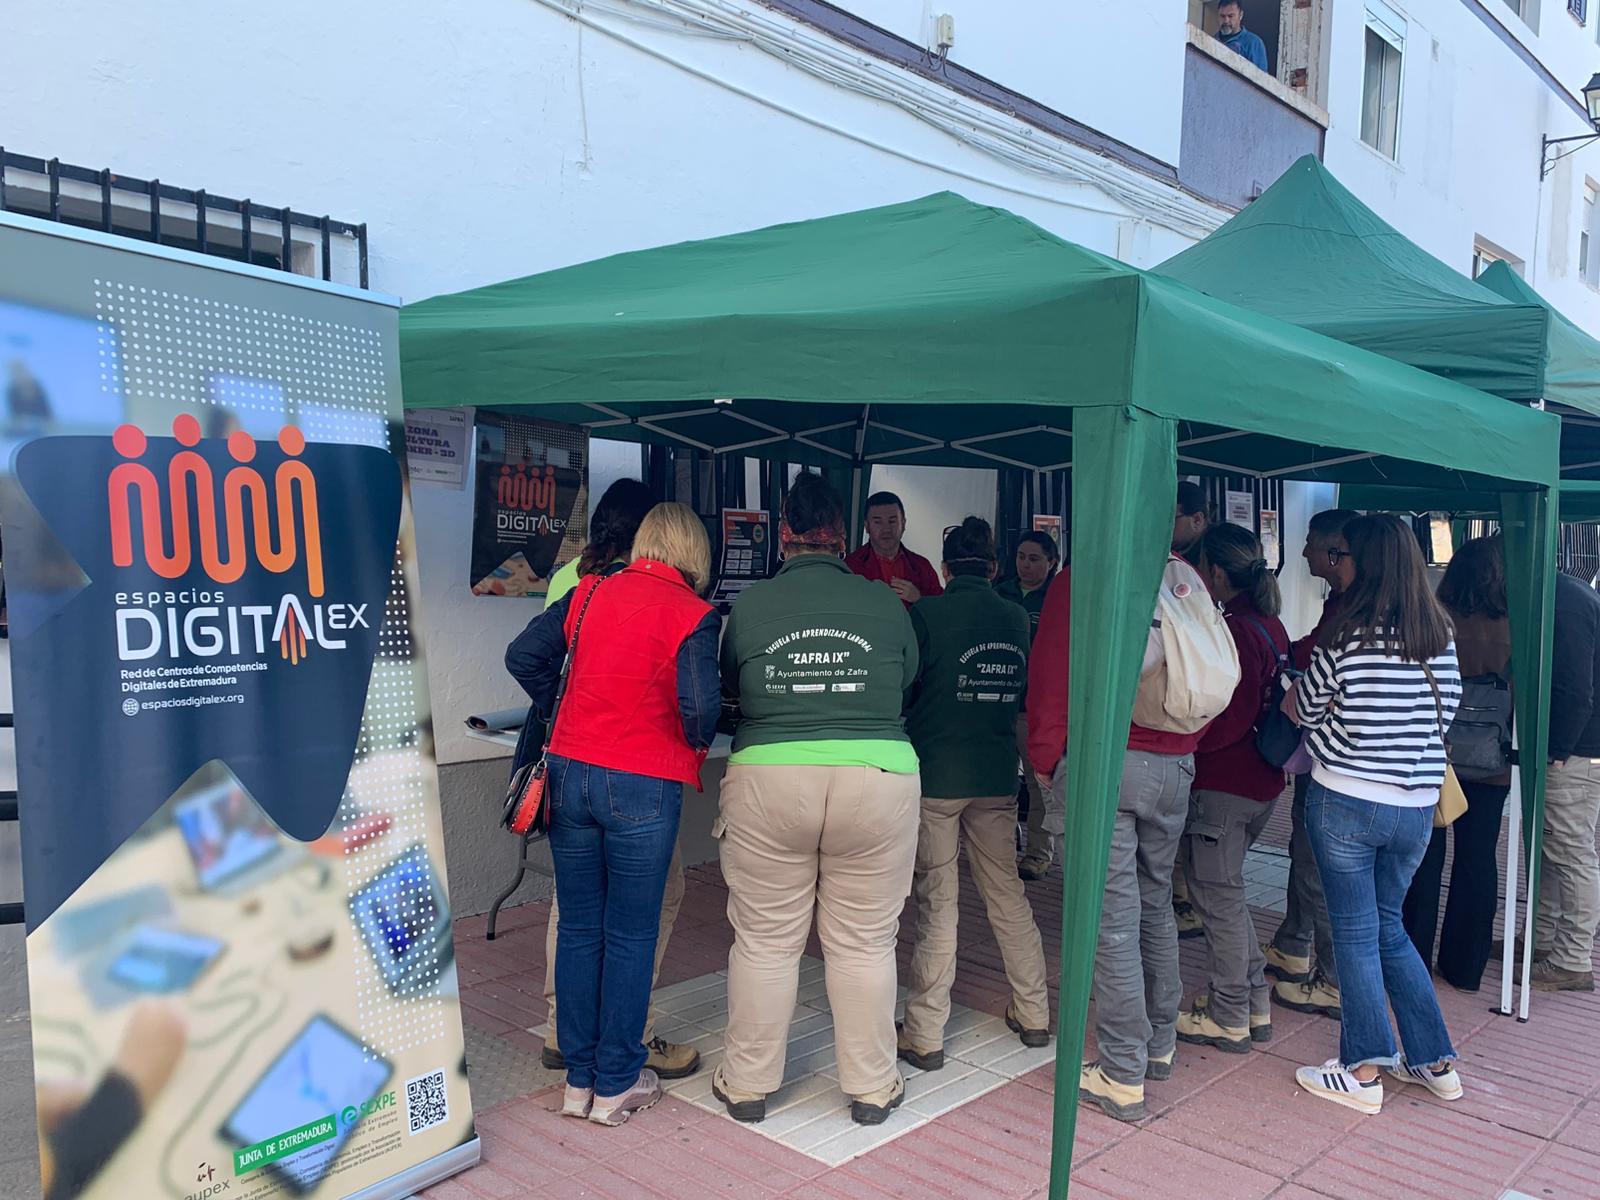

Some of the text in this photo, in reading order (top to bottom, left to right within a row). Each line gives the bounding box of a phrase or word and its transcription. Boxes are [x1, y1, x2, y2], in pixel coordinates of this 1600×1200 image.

[407, 425, 438, 437] ZONA
[406, 434, 450, 448] ULTURA
[115, 588, 225, 608] espacios
[115, 593, 370, 661] DIGITALEX
[765, 628, 873, 654] ESCUELA DE APRENDIZAJE LABORAL
[120, 661, 268, 680] Red de Centros de Competencias
[777, 669, 832, 679] Ayuntamiento
[847, 668, 868, 676] Zafra
[121, 676, 238, 693] Digitales de Extremadura
[141, 694, 244, 711] espaciosdigitalex.org
[360, 1091, 397, 1116] SEXPE
[239, 1149, 263, 1168] JUNTA
[266, 1142, 277, 1156] DE
[279, 1122, 333, 1150] EXTREMADURA
